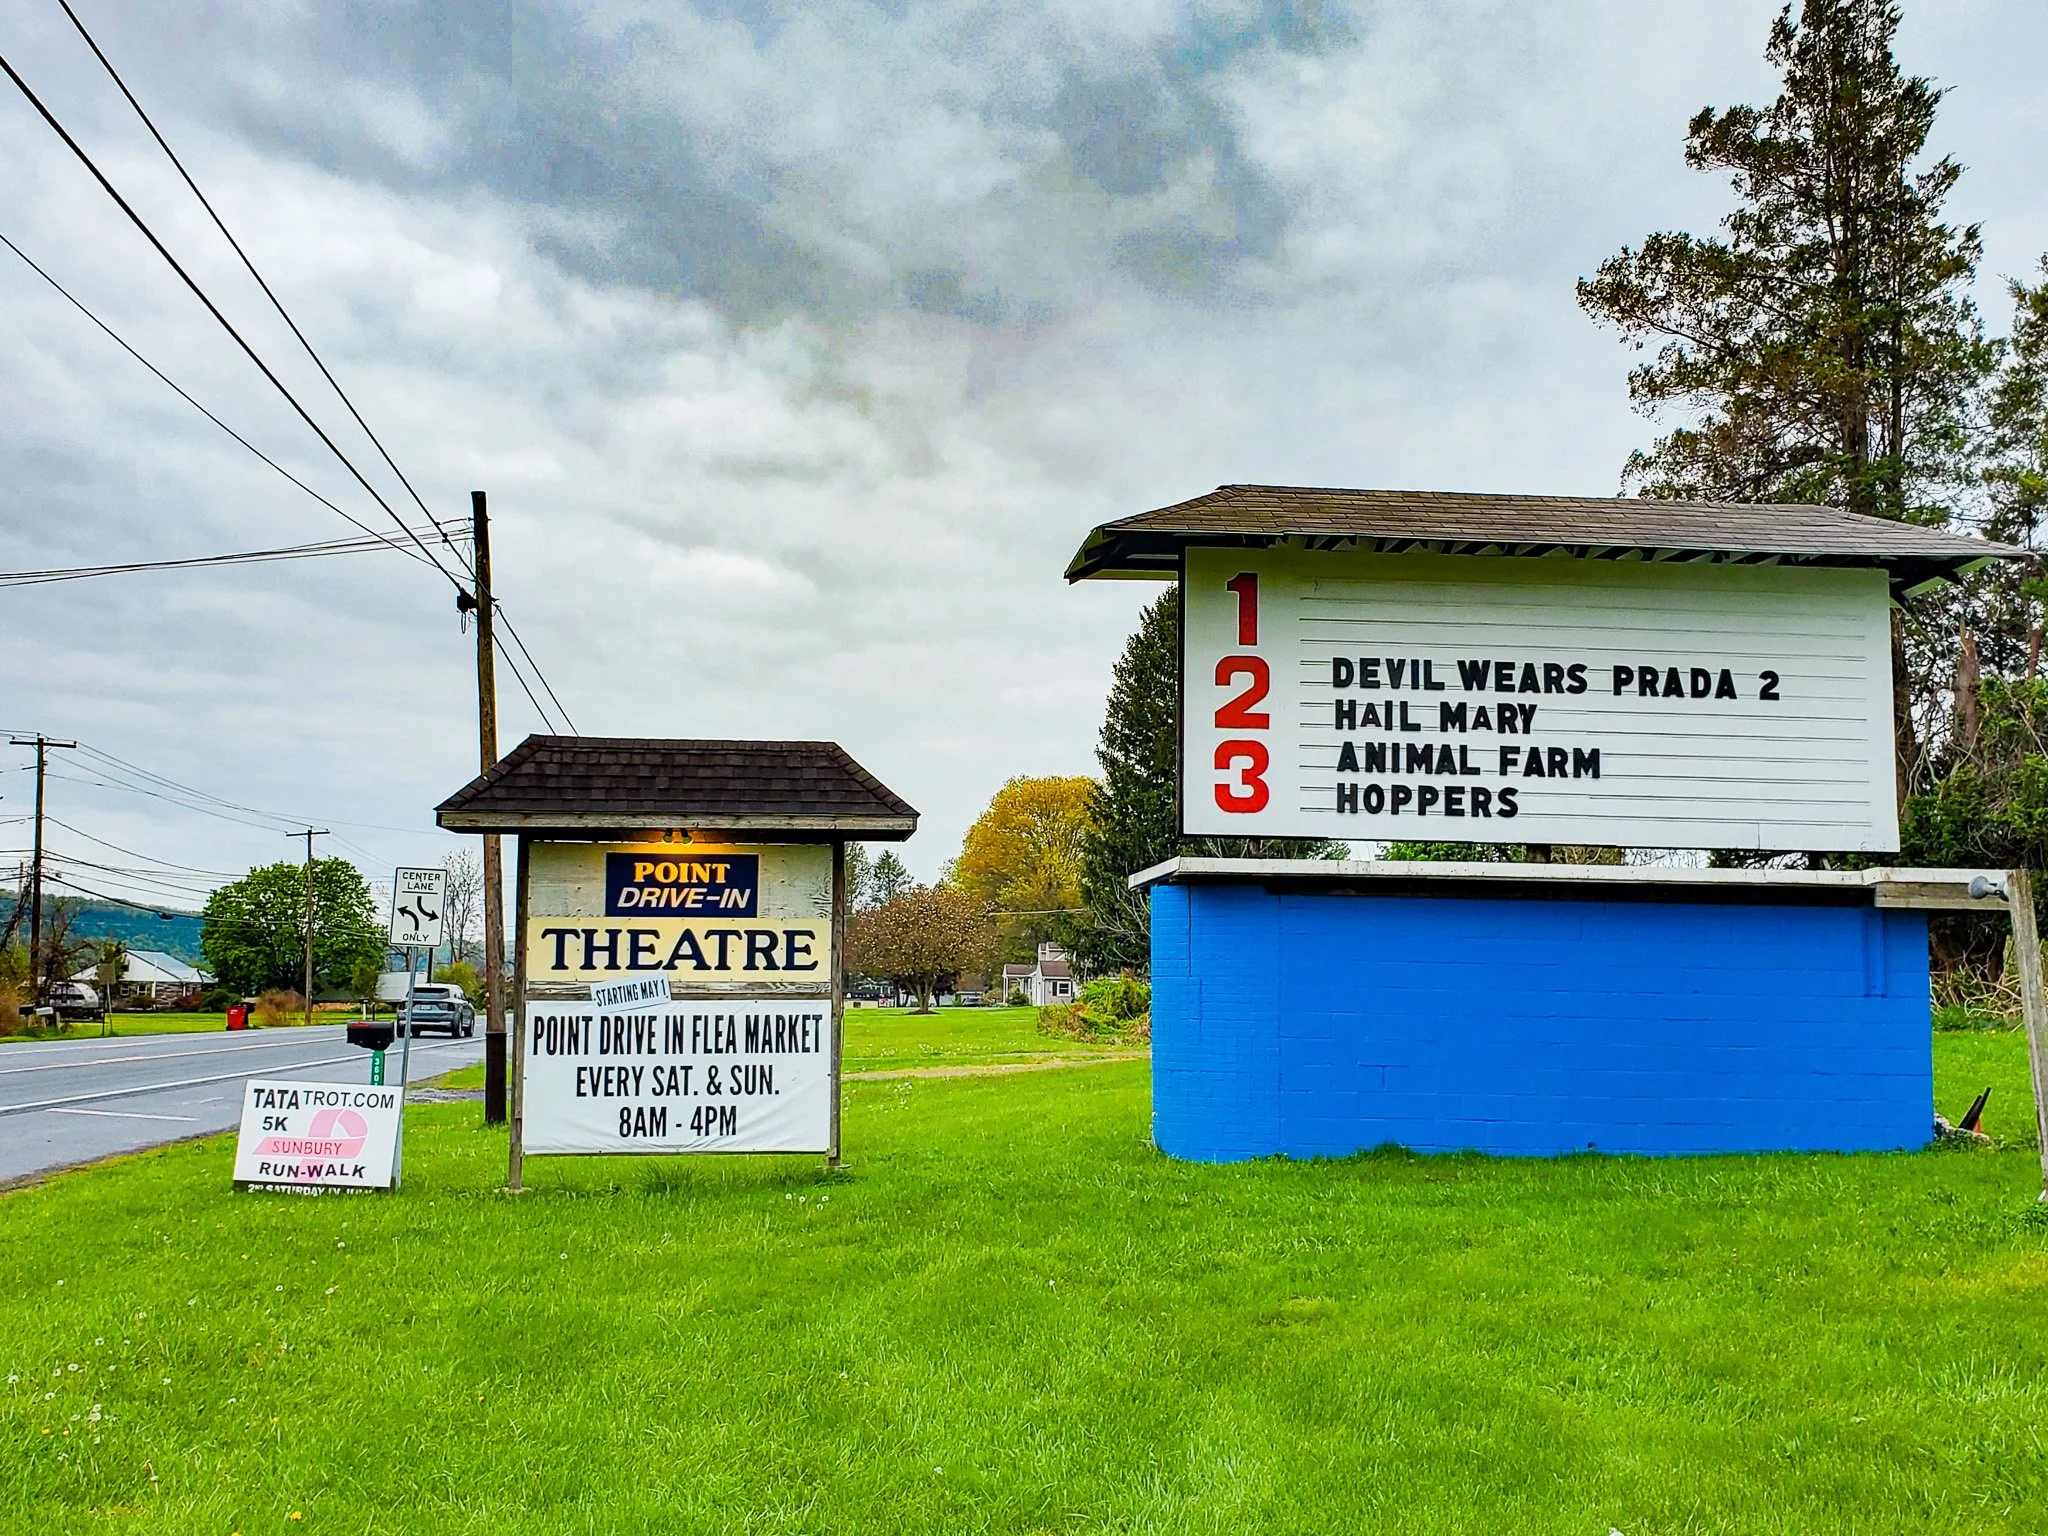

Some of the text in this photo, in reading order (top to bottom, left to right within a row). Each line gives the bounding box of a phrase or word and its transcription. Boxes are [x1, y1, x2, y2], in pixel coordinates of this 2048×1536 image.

[1226, 572, 1258, 646] 1
[1214, 655, 1270, 729] 2
[1332, 656, 1780, 700] DEVIL WEARS PRADA 2
[1335, 698, 1538, 735] HAIL MARY
[1214, 739, 1270, 813] 3
[1336, 741, 1601, 779] ANIMAL FARM
[1336, 782, 1519, 818] HOPPERS
[402, 871, 441, 881] CENTER
[407, 881, 434, 891] LANE
[633, 862, 730, 884] POINT
[617, 886, 751, 909] DRIVE-IN
[402, 932, 429, 942] ONLY
[541, 927, 819, 971] THEATRE
[596, 983, 639, 1007] STARTING
[640, 979, 659, 1000] MAY
[532, 1014, 823, 1056] POINT DRIVE IN FLEA MARKET
[576, 1064, 780, 1097] EVERY SAT. & SUN.
[262, 1116, 289, 1132] 5K
[619, 1106, 667, 1138] 8AM
[690, 1105, 737, 1137] 4PM
[271, 1140, 342, 1156] SUNBURY
[258, 1162, 366, 1179] RUN-WALK
